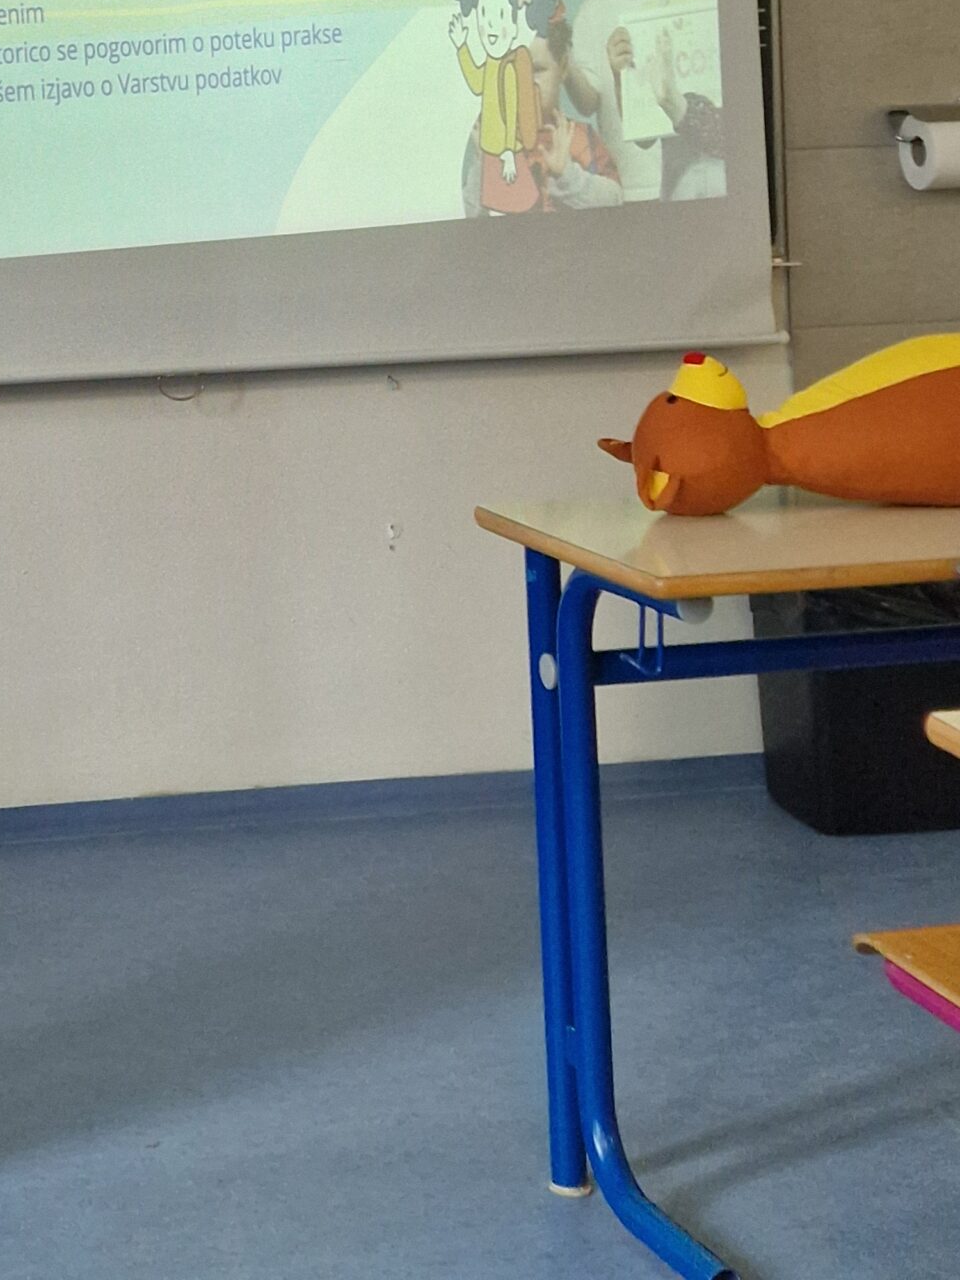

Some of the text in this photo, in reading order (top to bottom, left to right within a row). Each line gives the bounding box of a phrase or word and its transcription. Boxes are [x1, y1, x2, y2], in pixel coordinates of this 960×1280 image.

[57, 43, 78, 62] se
[84, 33, 186, 65] pogovorim
[192, 36, 203, 52] o
[210, 27, 275, 57] poteku
[281, 23, 342, 52] prakse
[41, 79, 95, 104] izjavo
[101, 82, 112, 97] o
[118, 73, 189, 94] Varstvu
[195, 65, 282, 95] podatkov
